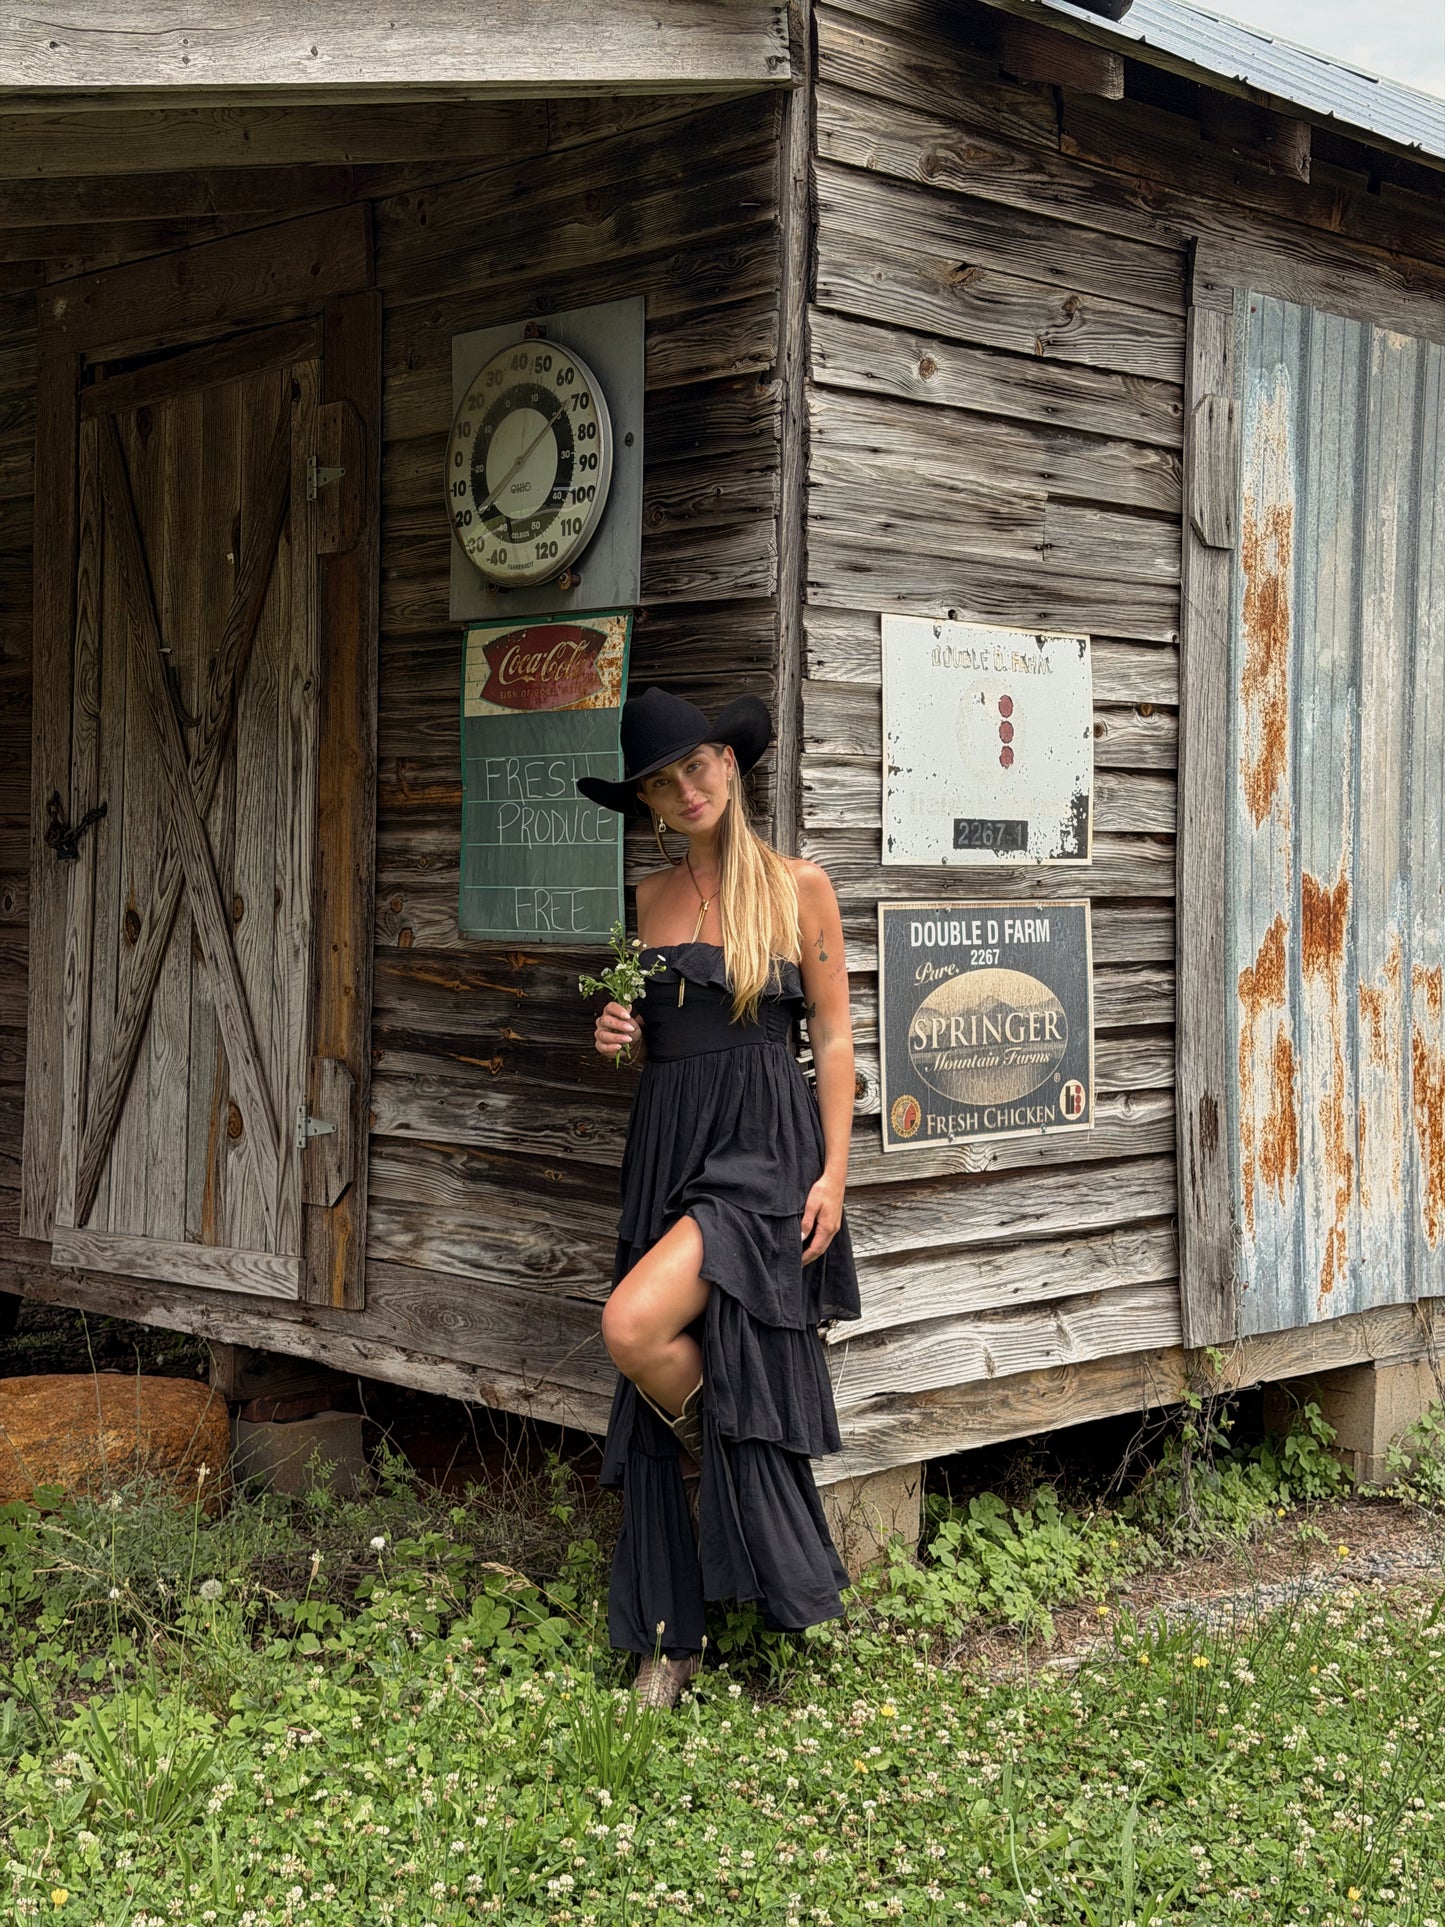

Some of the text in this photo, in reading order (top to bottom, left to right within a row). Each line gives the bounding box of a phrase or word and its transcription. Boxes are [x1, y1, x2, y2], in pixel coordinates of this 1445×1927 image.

[510, 353, 529, 371] 40
[534, 355, 553, 374] 50
[486, 369, 503, 387] 30
[556, 367, 575, 386] 60
[468, 393, 485, 411] 20
[570, 392, 590, 411] 70
[456, 421, 471, 439] 10
[577, 422, 596, 441] 80
[454, 451, 463, 467] 0
[579, 453, 598, 472] 90
[450, 479, 467, 497] -10
[571, 485, 596, 505] 100
[561, 517, 583, 537] 110
[486, 548, 508, 566] -40
[535, 541, 558, 560] 120
[931, 645, 989, 671] DOUBLE
[485, 755, 591, 805] FRESH
[497, 802, 616, 849] PRODUCE
[514, 887, 598, 932] FREE
[910, 920, 982, 947] DOUBLE
[987, 920, 999, 945] D
[1004, 918, 1051, 944] FARM
[970, 949, 1000, 965] 2267
[913, 1010, 1063, 1051] SPRINGER
[924, 1047, 1051, 1072] Mountain Farms
[926, 1105, 1056, 1135] FRESH CHICKEN
